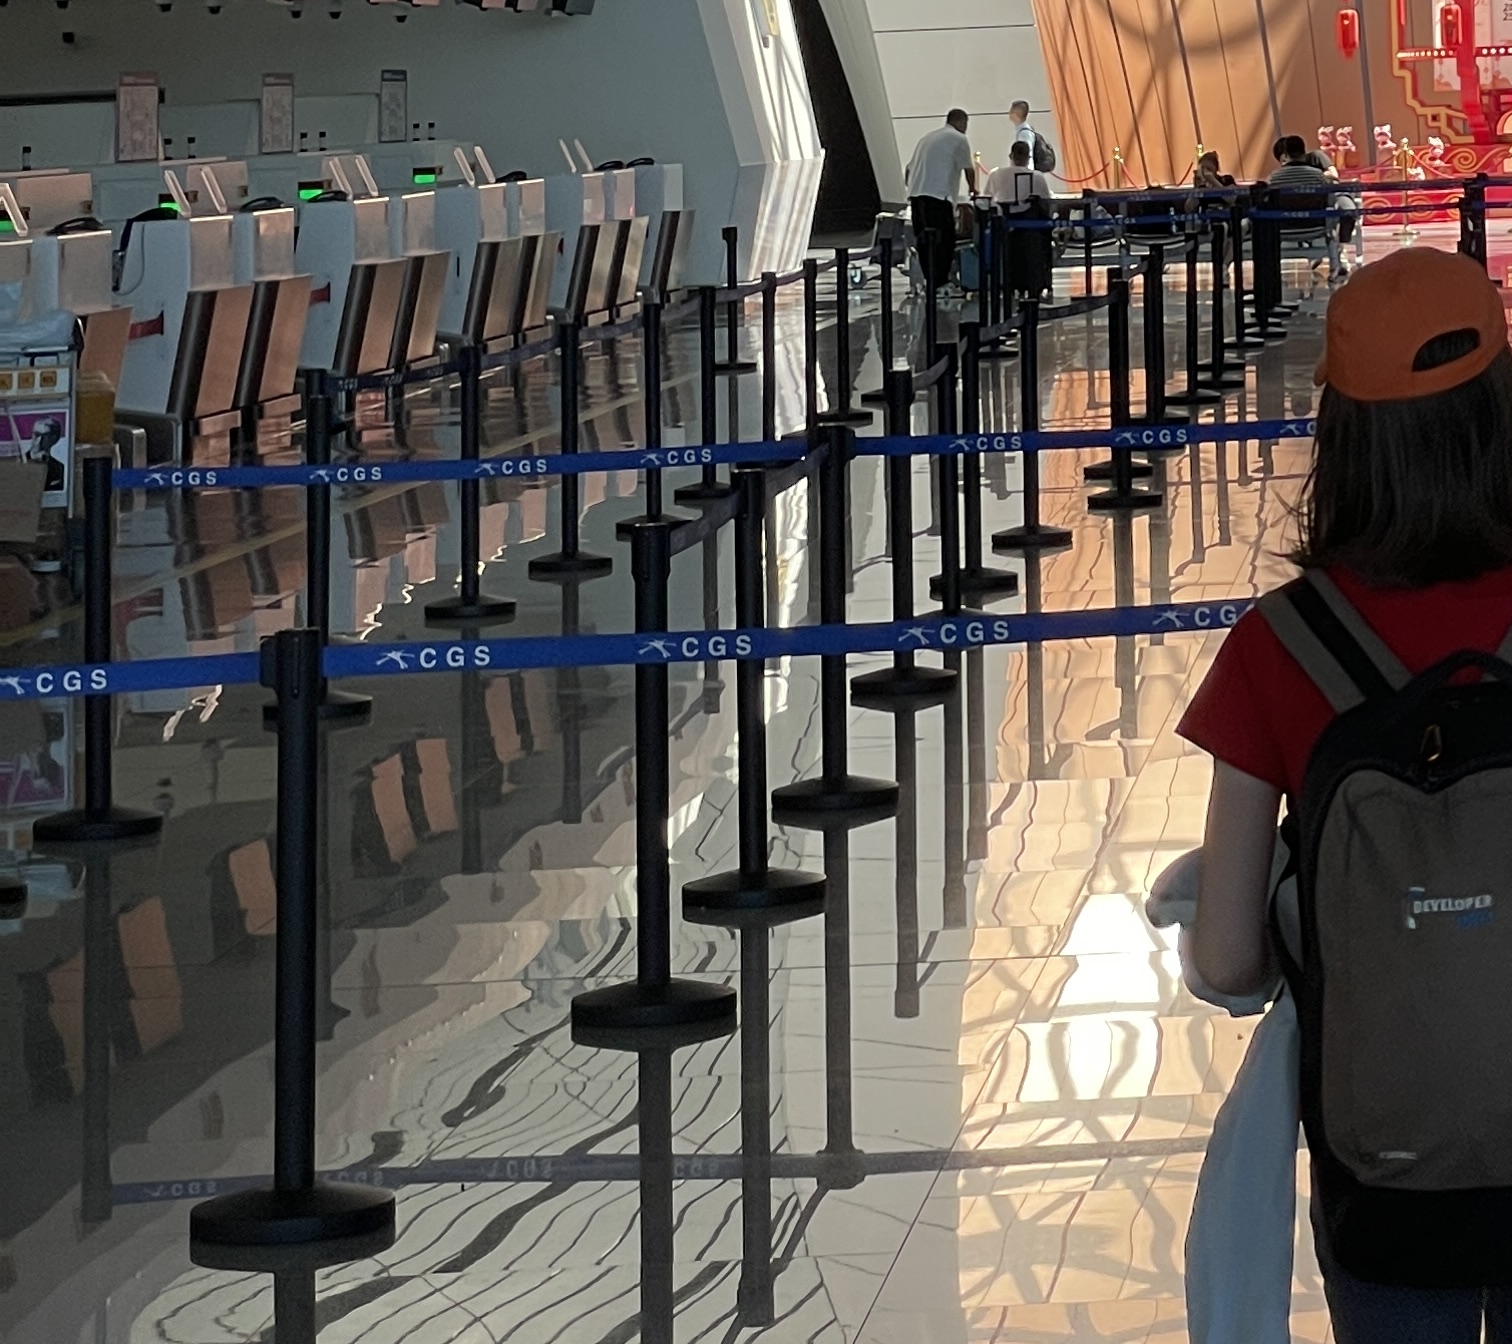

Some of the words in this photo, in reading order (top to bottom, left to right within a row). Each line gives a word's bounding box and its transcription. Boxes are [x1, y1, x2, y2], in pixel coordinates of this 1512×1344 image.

[977, 435, 1022, 450] CGS
[1142, 428, 1187, 444] CGS
[171, 471, 216, 485] CGS
[337, 466, 382, 482] CGS
[502, 459, 547, 475] CGS
[667, 448, 712, 464] CGS
[419, 645, 490, 668] CGS
[682, 635, 751, 657] CGS
[940, 621, 1009, 644] CGS
[1194, 605, 1238, 626] CG
[36, 669, 107, 693] CGS
